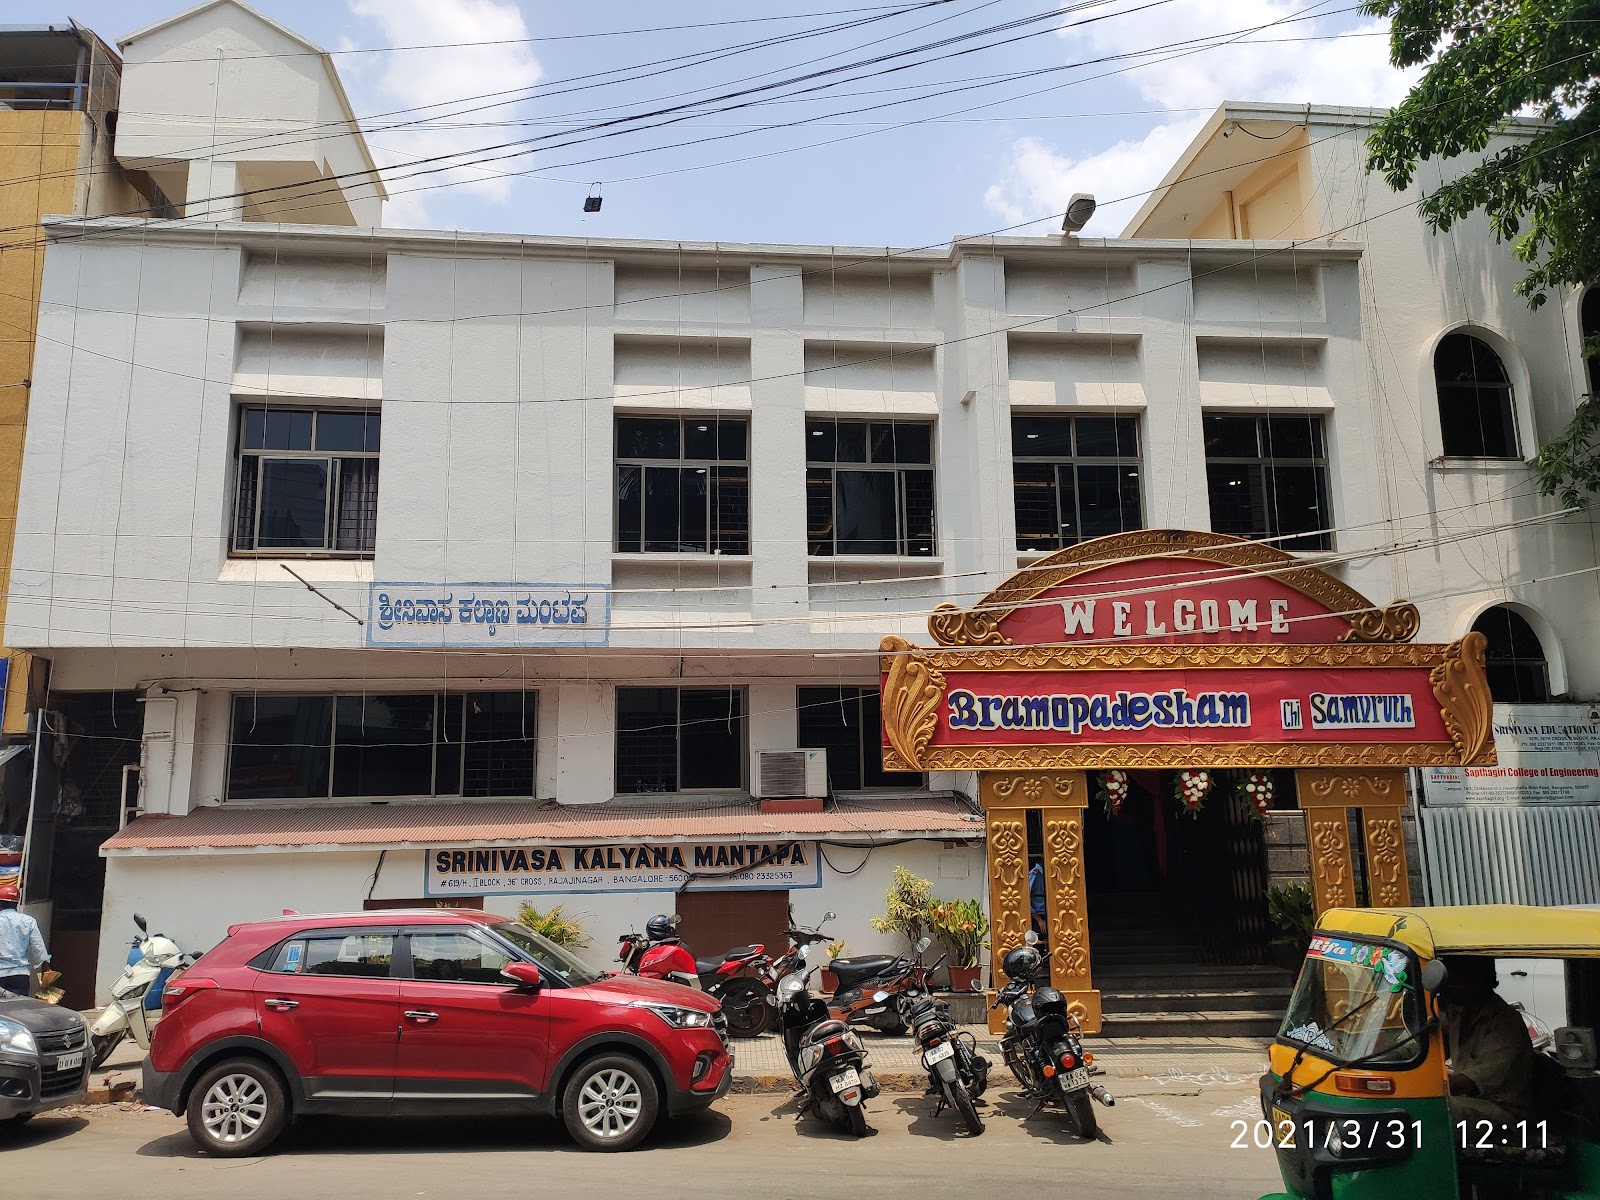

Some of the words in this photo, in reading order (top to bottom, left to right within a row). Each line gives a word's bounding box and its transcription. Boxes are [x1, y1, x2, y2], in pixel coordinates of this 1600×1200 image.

[948, 689, 1250, 734] Bramopadesham
[1283, 701, 1300, 728] Chi
[1464, 767, 1507, 778] Sapthagiri
[1508, 767, 1539, 778] College
[1540, 767, 1548, 777] of
[1549, 767, 1599, 778] Engineering
[436, 848, 565, 874] SRINIVASA
[574, 846, 687, 871] KALYANA
[694, 843, 808, 870] MANTAPA
